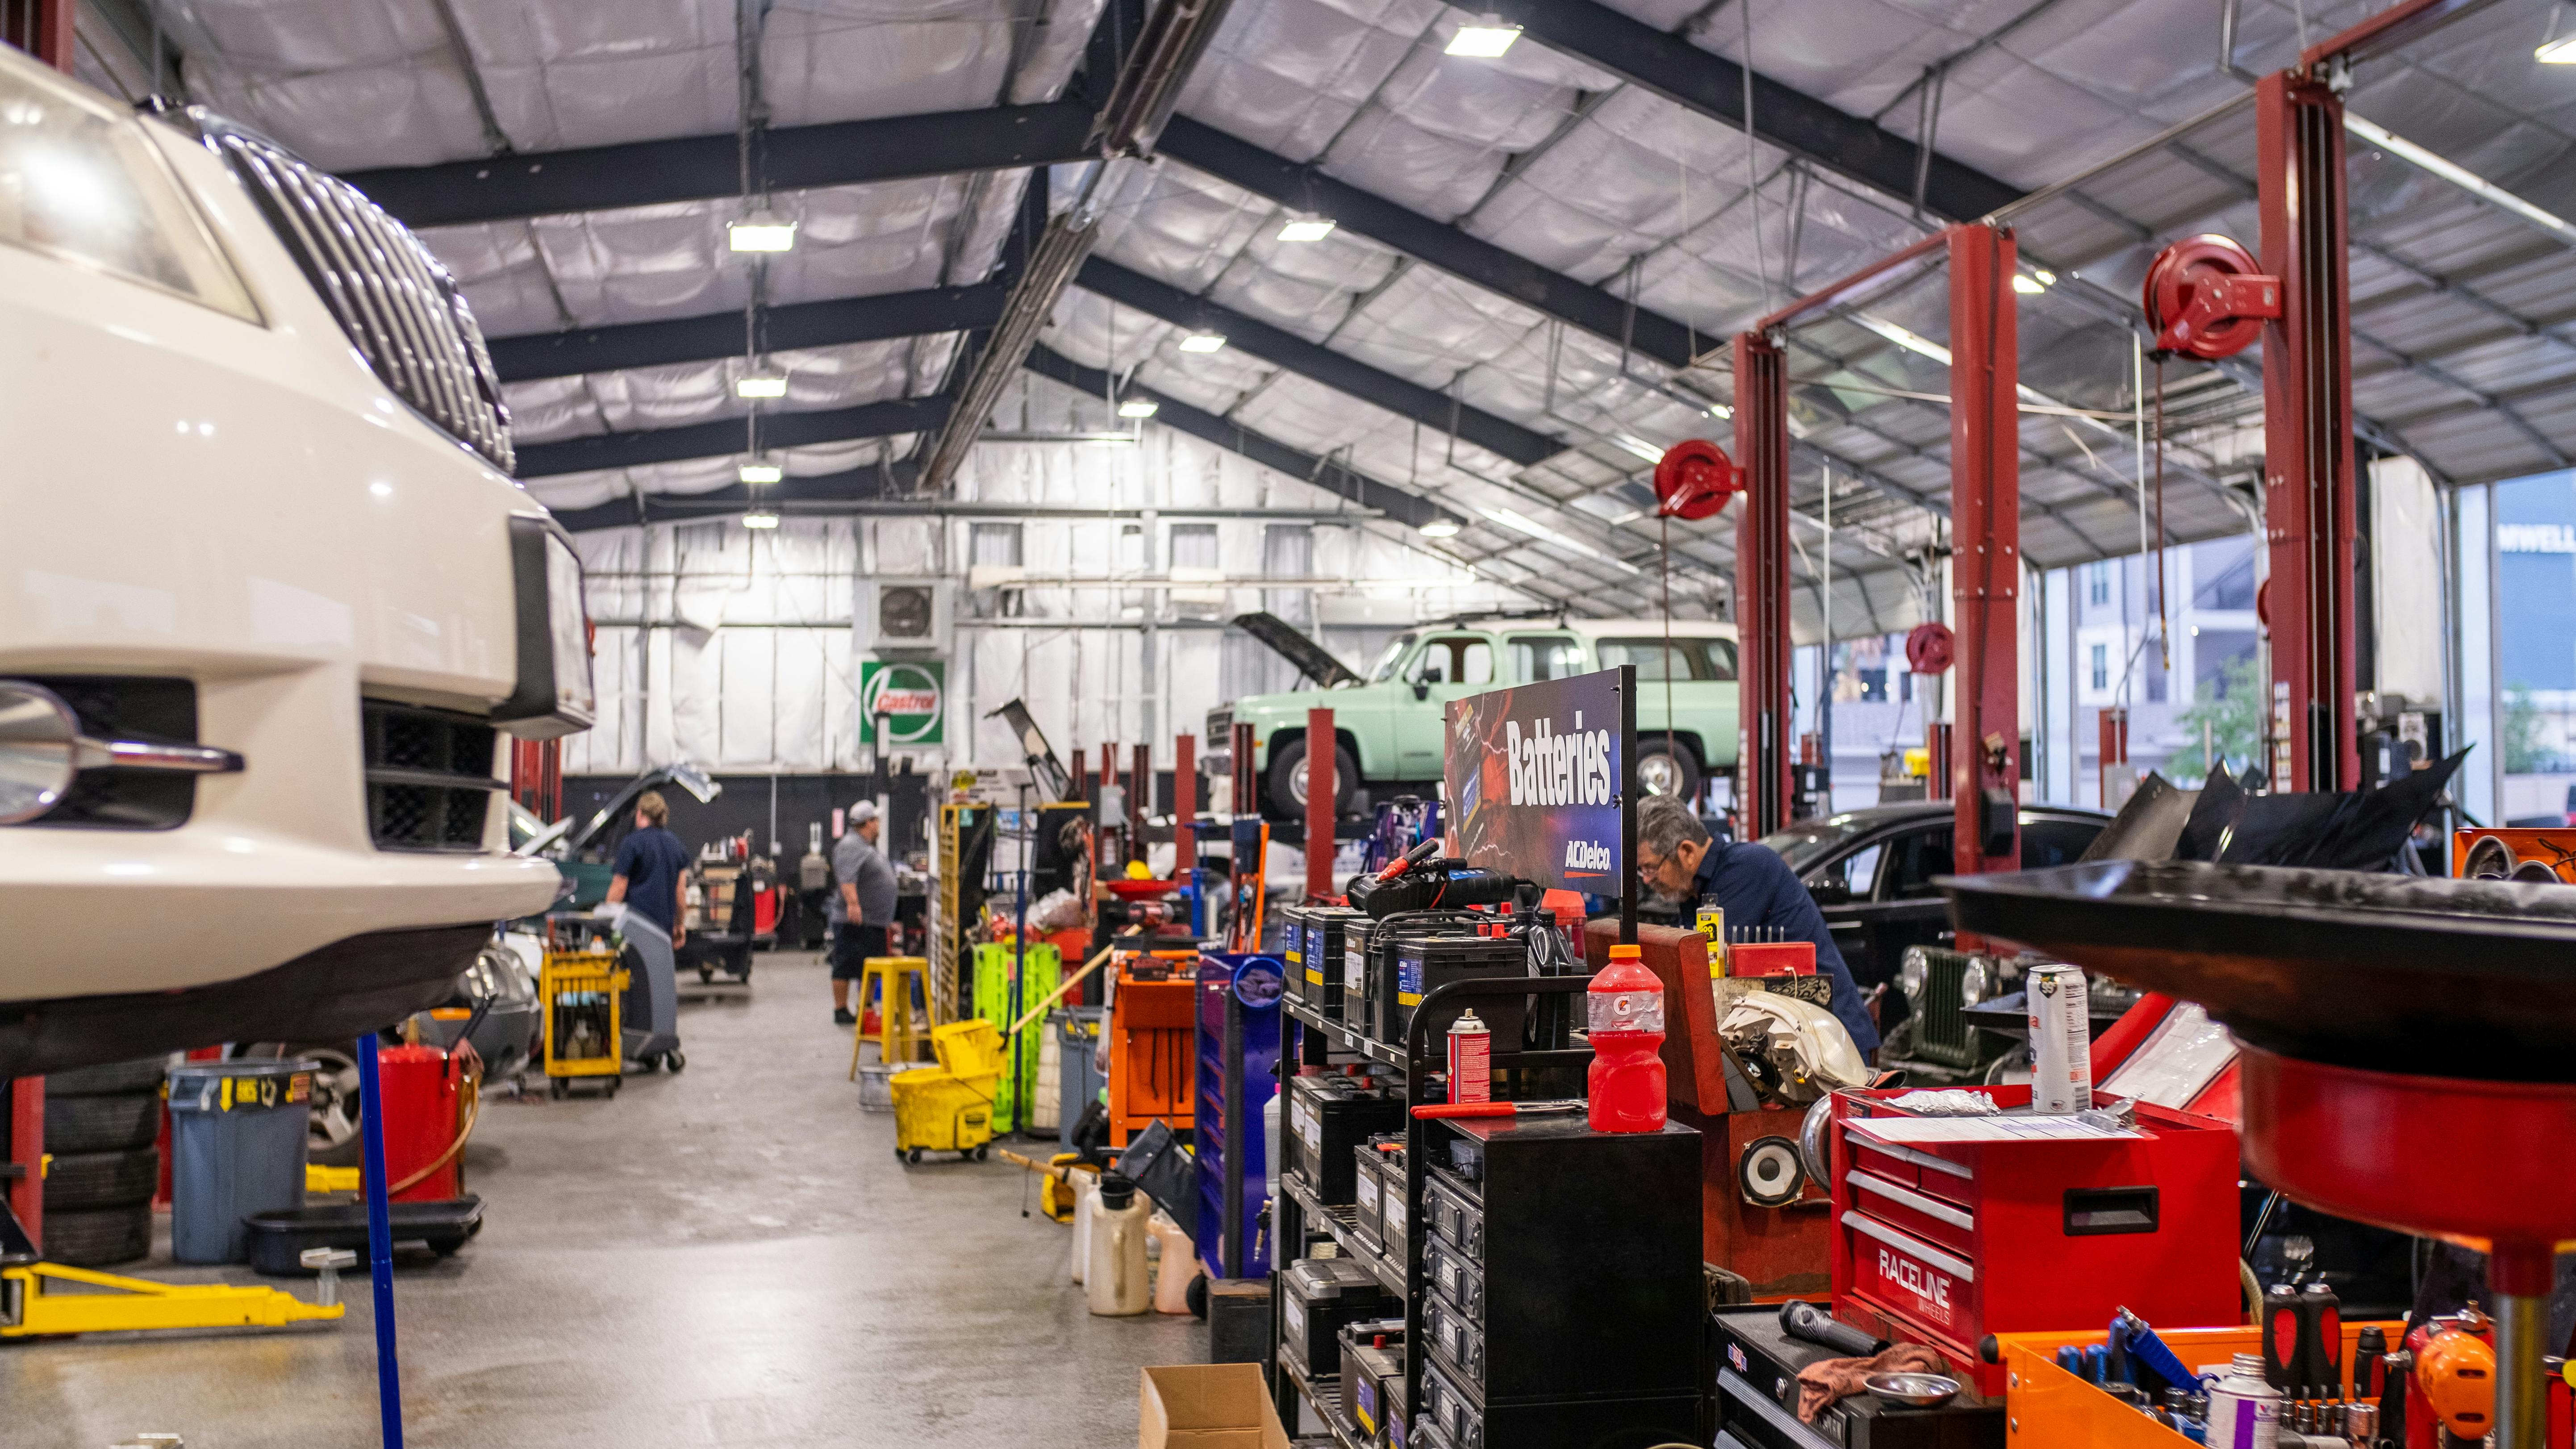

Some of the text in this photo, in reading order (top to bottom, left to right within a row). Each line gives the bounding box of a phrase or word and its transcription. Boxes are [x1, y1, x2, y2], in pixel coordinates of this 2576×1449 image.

[877, 693, 936, 710] Castrol
[1506, 710, 1611, 807] Batteries
[1565, 840, 1611, 871] ACDelco
[1879, 1248, 1950, 1310] RACELINE
[1918, 1296, 1950, 1325] WHEELS
